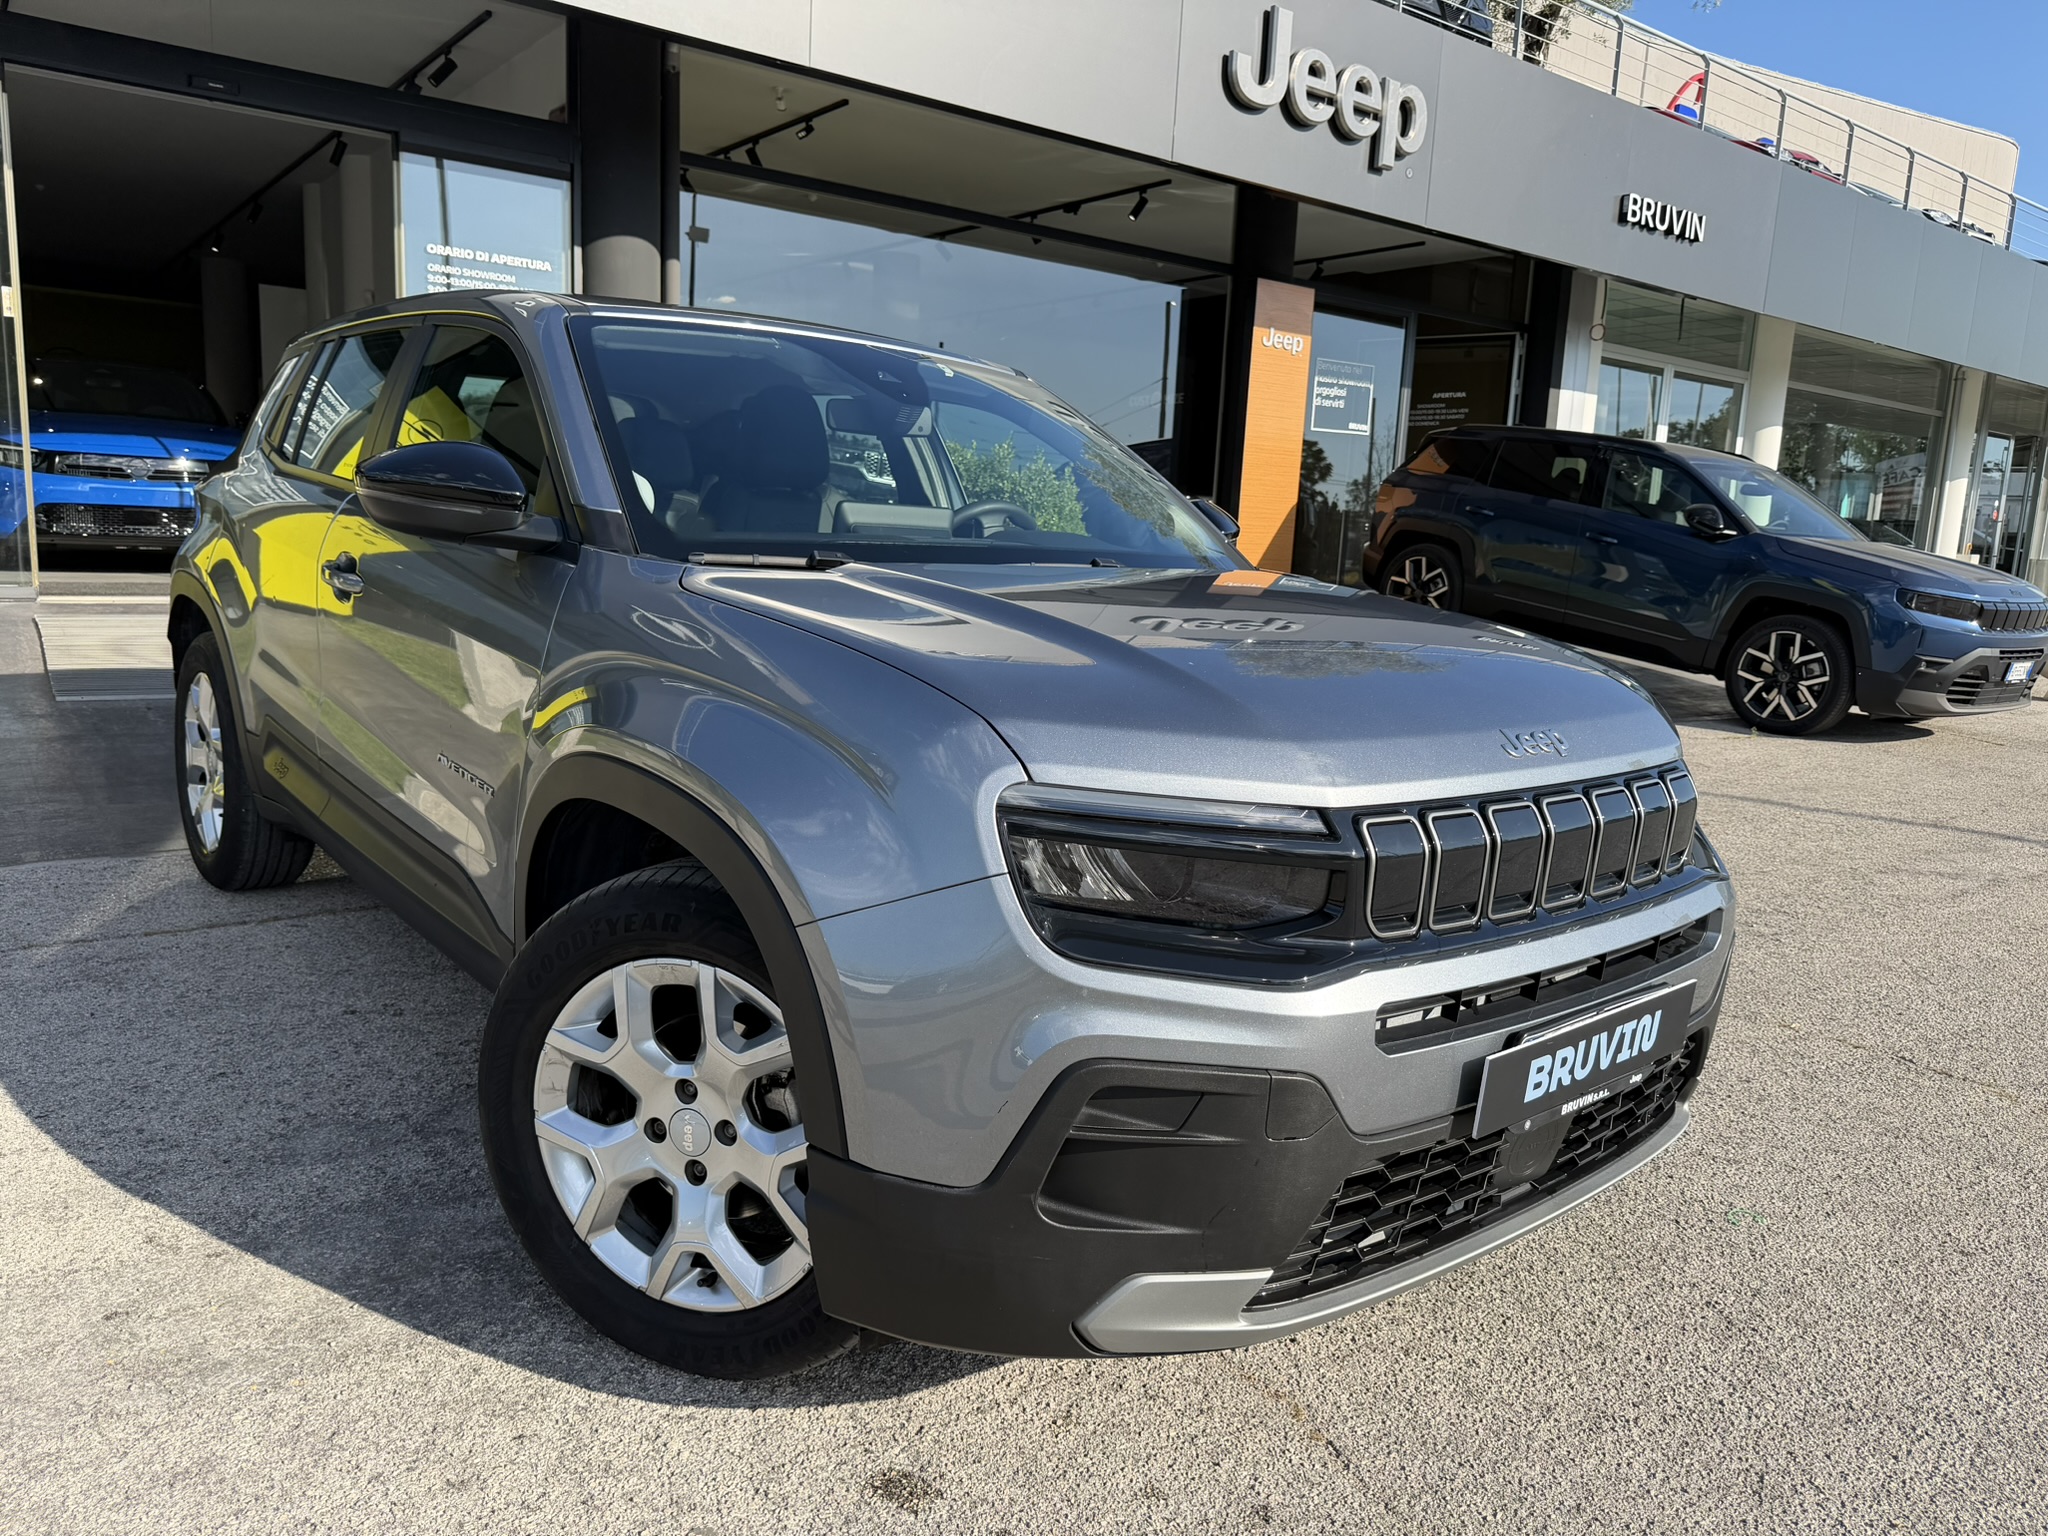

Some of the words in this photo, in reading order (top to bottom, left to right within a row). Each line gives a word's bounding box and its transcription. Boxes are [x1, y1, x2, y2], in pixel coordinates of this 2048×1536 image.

[1226, 4, 1428, 171] Jeep
[1626, 192, 1707, 242] BRUVIN
[426, 243, 474, 260] ORARIO
[475, 251, 489, 262] DI
[490, 253, 553, 272] APERTURA
[426, 263, 462, 276] ORARIO
[462, 267, 516, 283] SHOWROOM
[1262, 327, 1304, 356] Jeep
[1432, 391, 1467, 399] APERTURA
[1499, 728, 1569, 759] Jeep
[437, 752, 495, 798] AVENGER
[1523, 1009, 1663, 1104] BRUVIN
[1560, 1092, 1594, 1116] BRUVIN
[683, 1114, 697, 1152] Jeep
